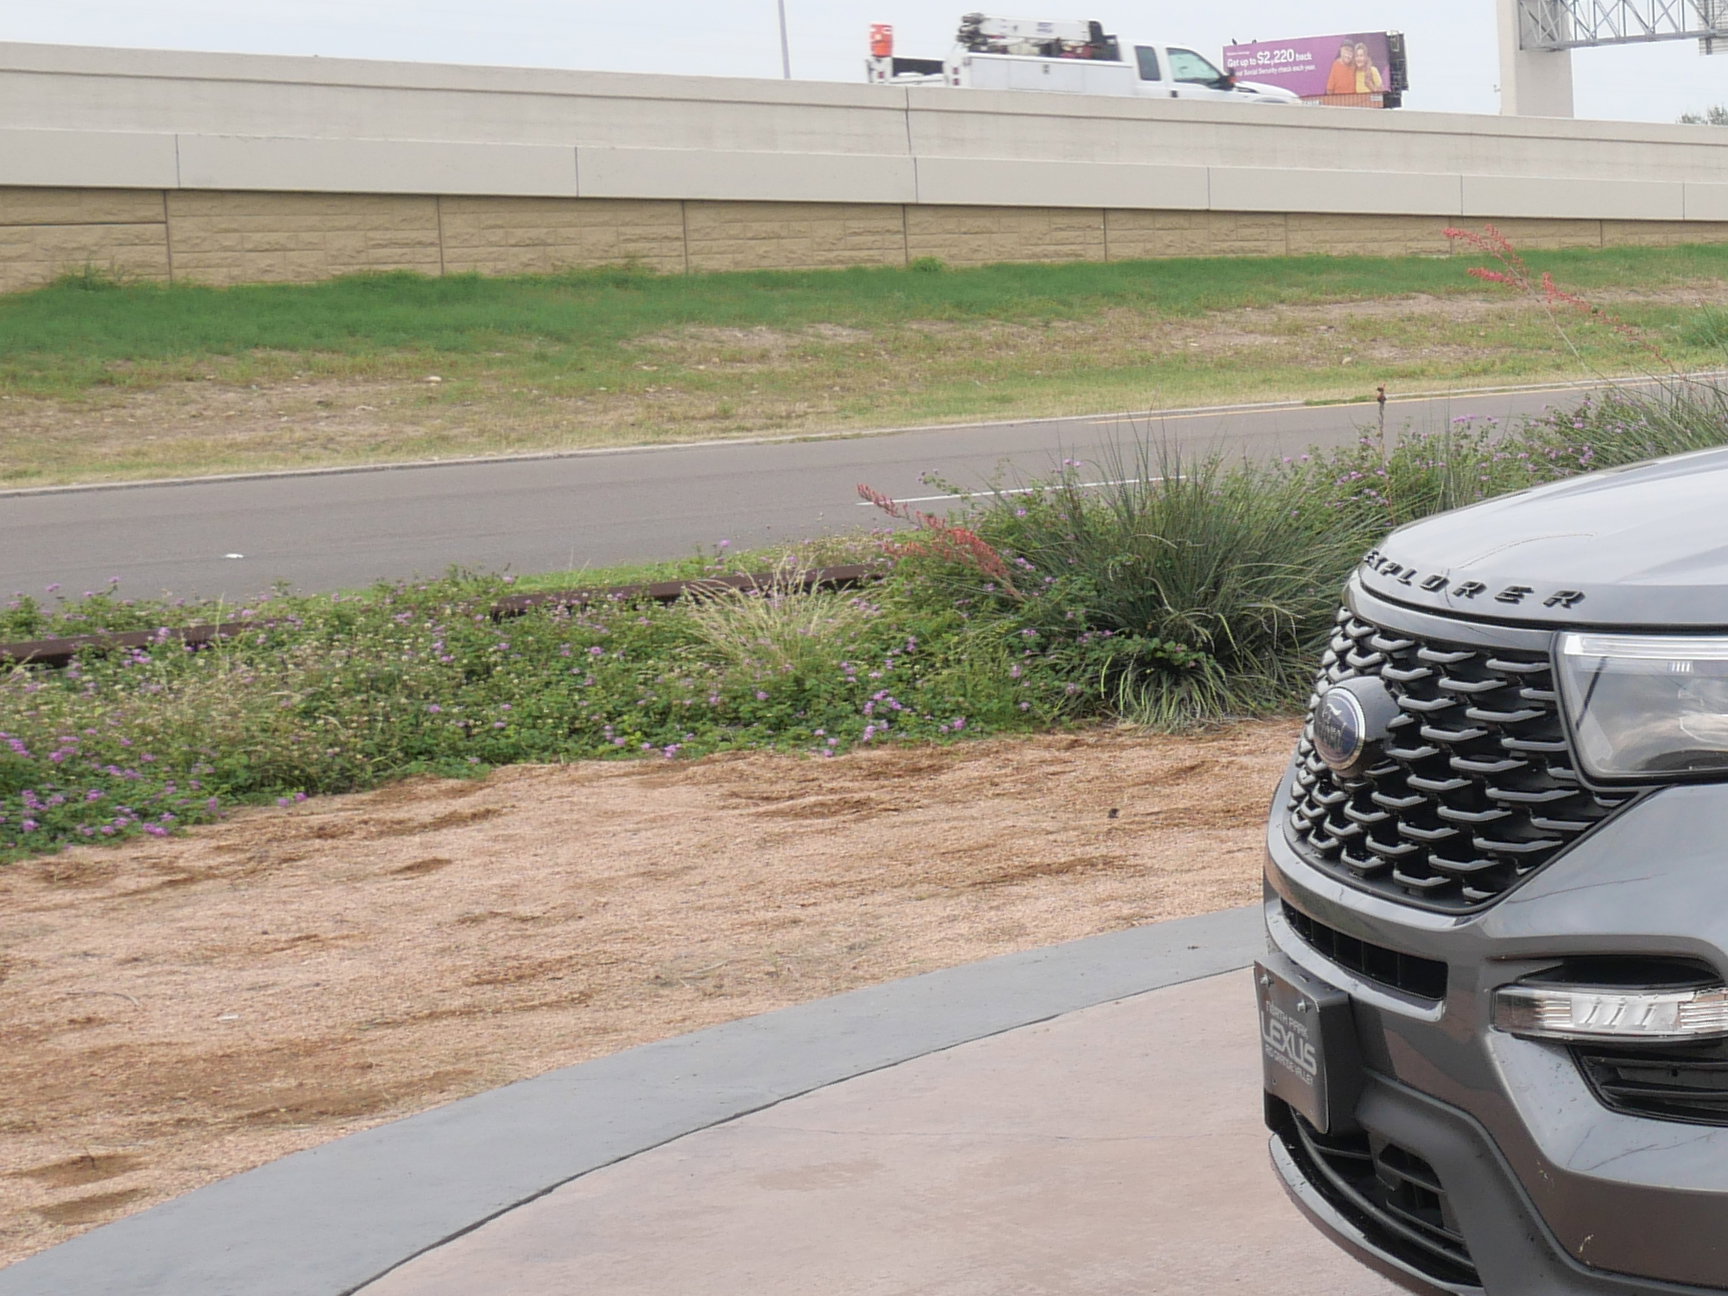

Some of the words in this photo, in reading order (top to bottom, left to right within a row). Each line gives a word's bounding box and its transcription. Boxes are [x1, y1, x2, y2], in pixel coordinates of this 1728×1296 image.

[1227, 58, 1239, 67] Get
[1240, 58, 1249, 67] up
[1249, 57, 1257, 65] to
[1257, 49, 1294, 66] $2,220
[1296, 52, 1312, 61] back
[1364, 550, 1586, 609] EXPLORER
[1261, 1010, 1317, 1076] LEXUS
